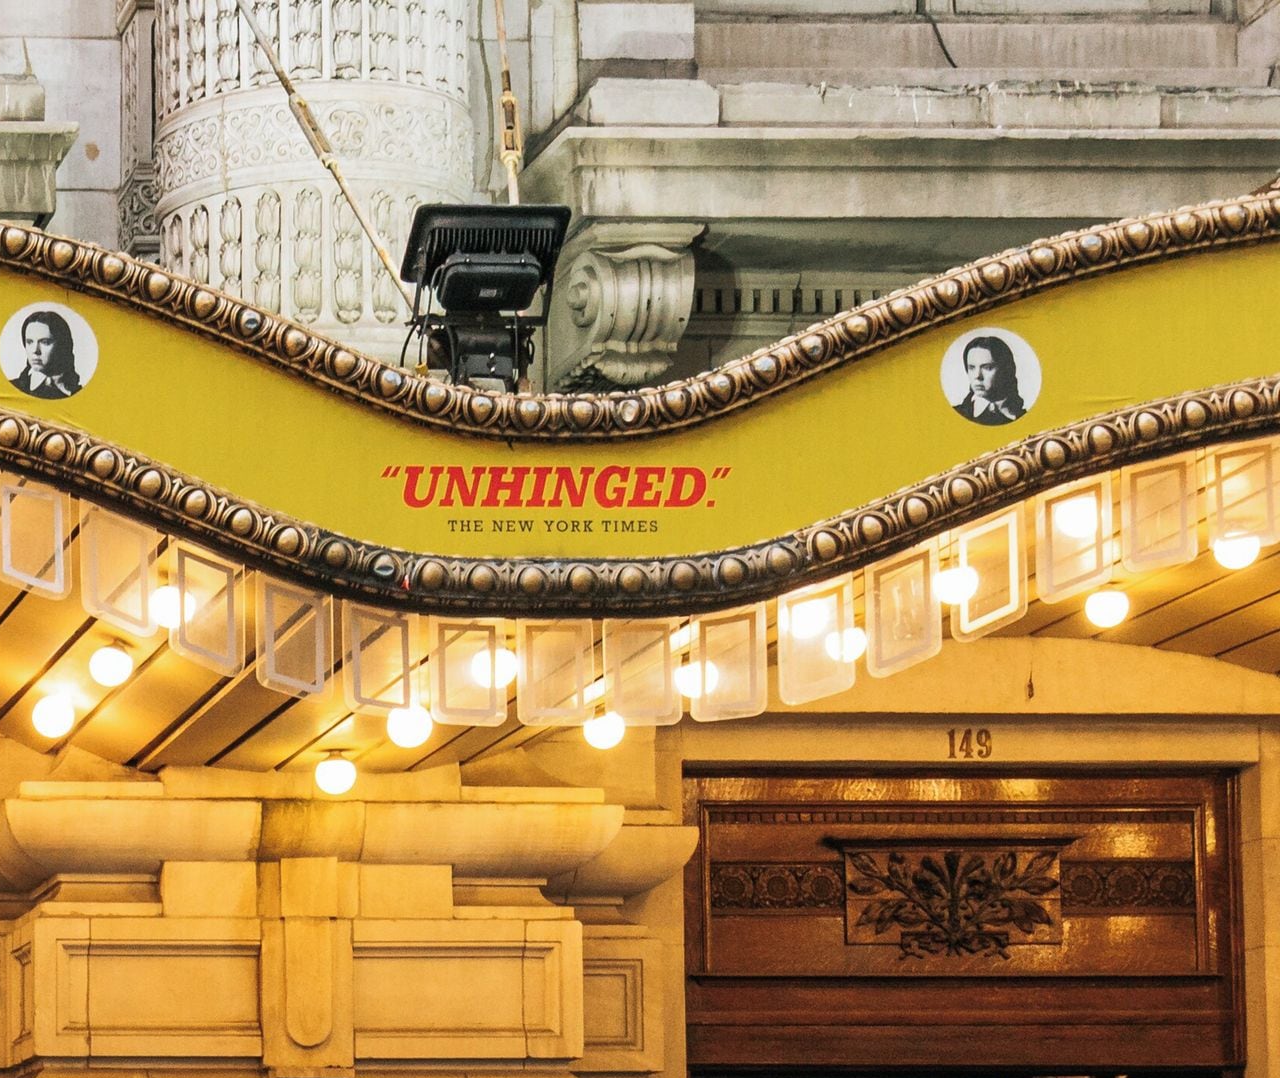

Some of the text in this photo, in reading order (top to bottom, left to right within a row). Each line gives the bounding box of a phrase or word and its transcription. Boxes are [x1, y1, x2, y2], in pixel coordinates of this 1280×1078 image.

[380, 465, 732, 509] “UNHINGED.”
[448, 520, 659, 533] THE NEW YORK TIMES
[947, 728, 992, 758] 149
